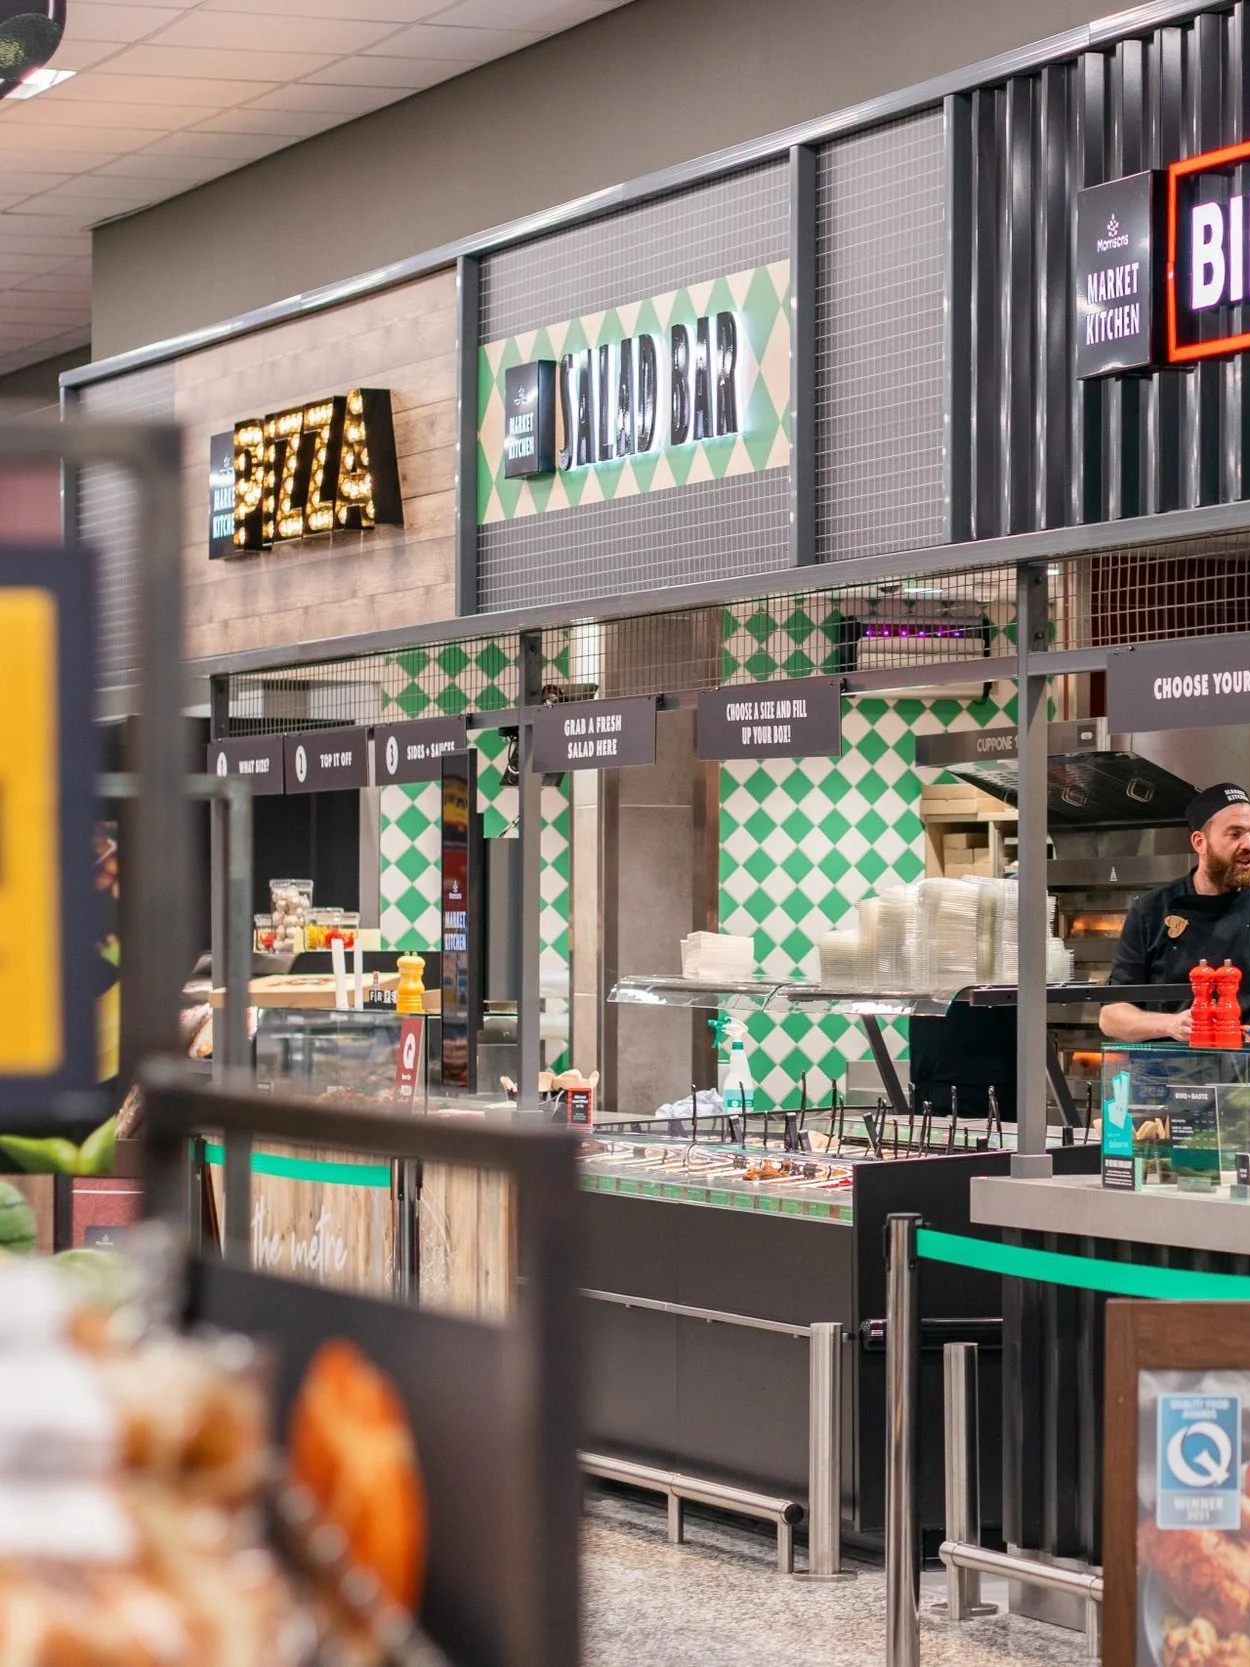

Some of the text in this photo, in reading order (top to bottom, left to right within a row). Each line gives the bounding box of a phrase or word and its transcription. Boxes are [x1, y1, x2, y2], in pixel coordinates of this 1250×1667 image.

[1096, 233, 1129, 252] Morrisons
[1087, 262, 1139, 305] MARKET
[1086, 303, 1140, 345] KITCHEN
[559, 310, 742, 472] SALAD BAR
[508, 412, 535, 435] MARKET
[507, 435, 535, 460] KITCHEN
[233, 388, 398, 552] PIZZA
[1153, 674, 1209, 700] CHOOSE
[726, 699, 808, 722] CHOOSE A SIZE AND FILL
[564, 714, 622, 736] GRAB A FRESH
[742, 725, 791, 745] UP YOUR BOX!
[407, 744, 425, 760] SIDES
[568, 738, 618, 759] SALAD HERE
[977, 736, 1013, 752] CUPPONE
[239, 760, 254, 774] WHAT
[320, 752, 332, 768] TOP
[333, 752, 340, 767] IT
[341, 751, 353, 766] OFF
[251, 1194, 348, 1284] the metre
[1173, 1496, 1224, 1511] WINNER
